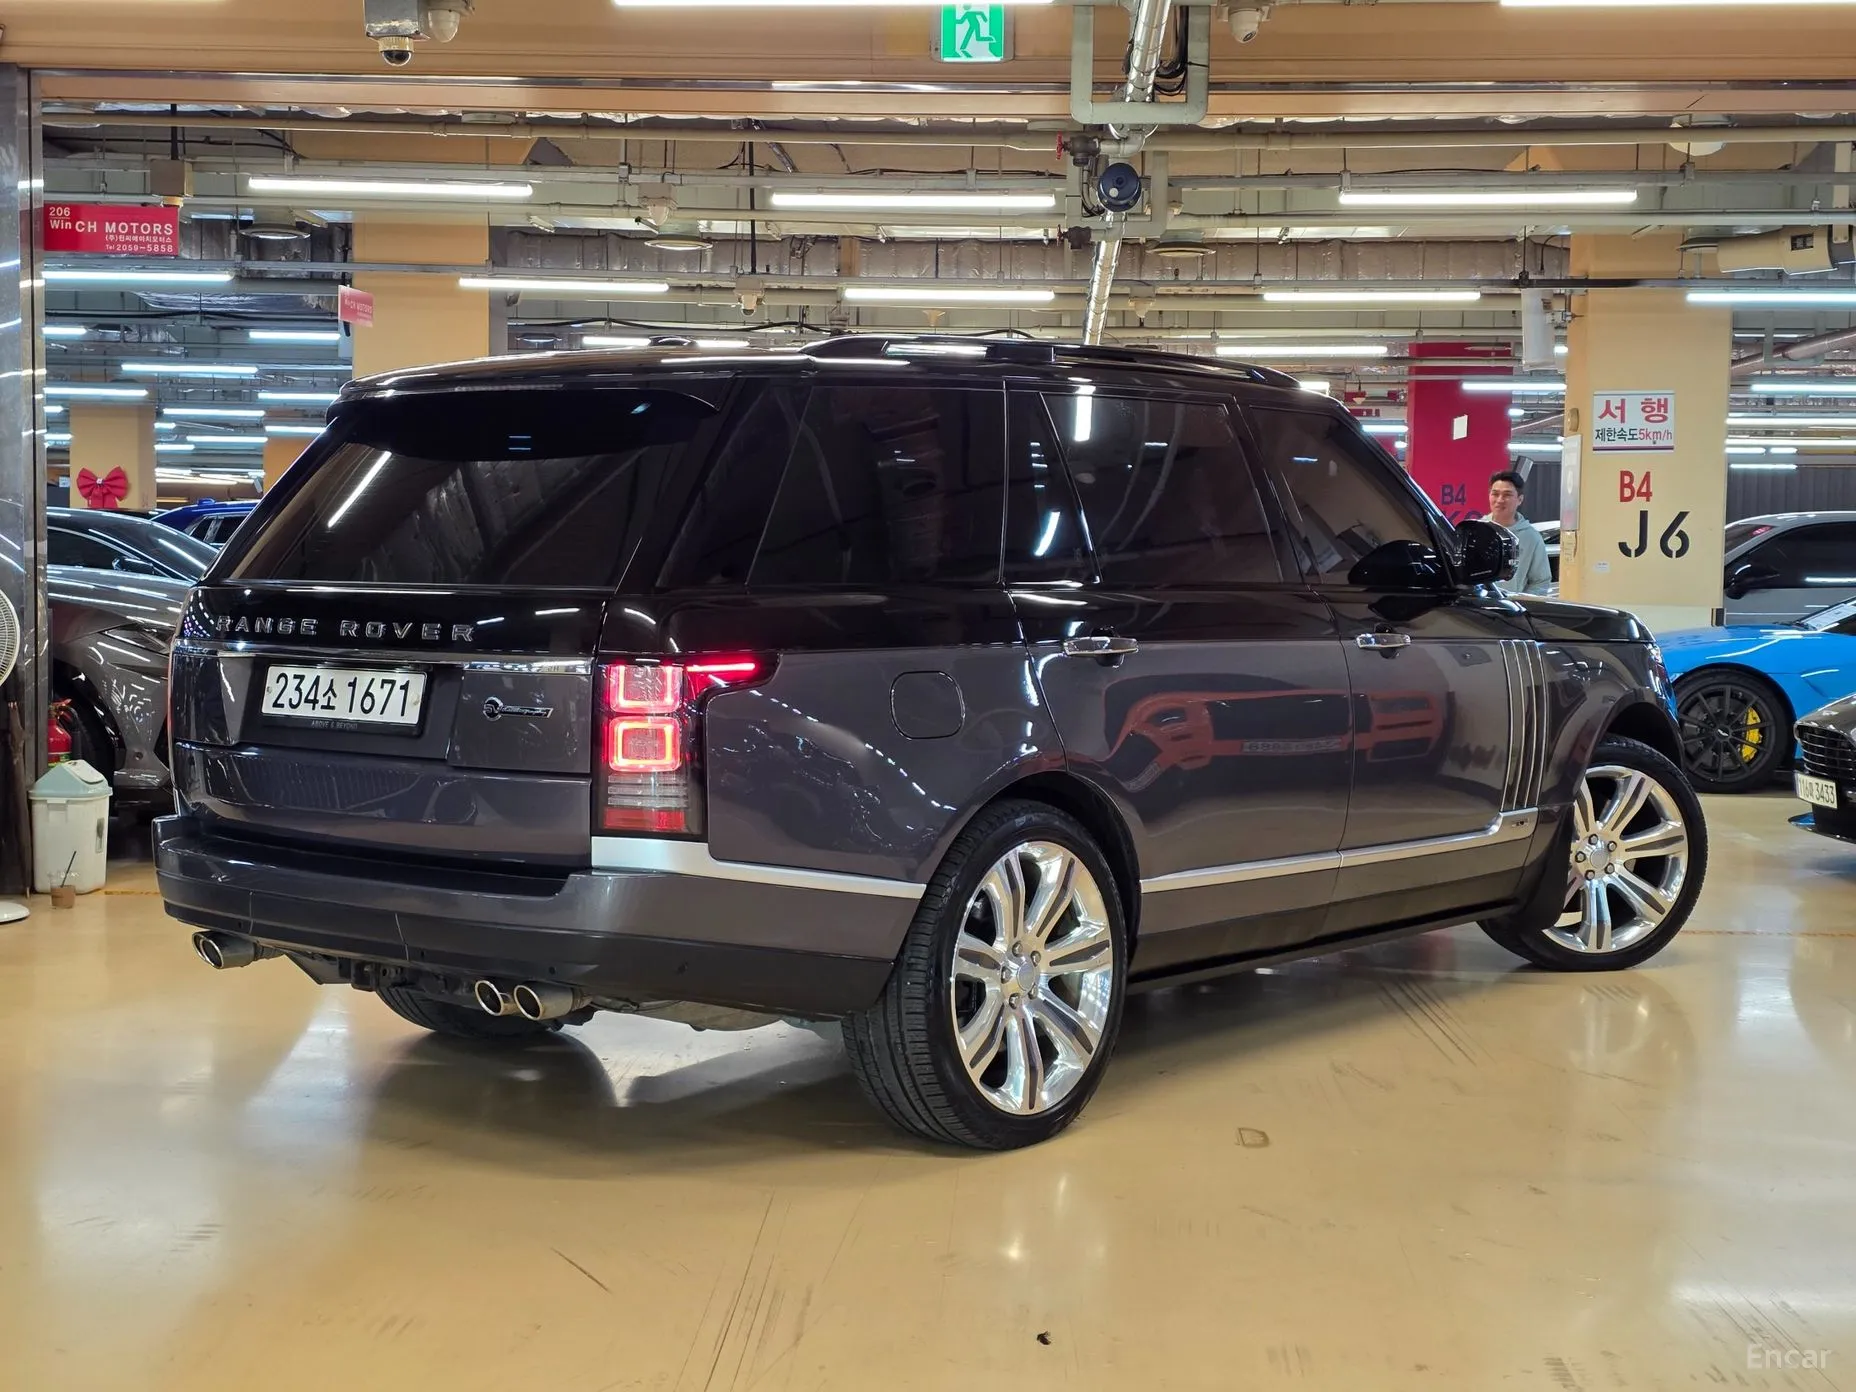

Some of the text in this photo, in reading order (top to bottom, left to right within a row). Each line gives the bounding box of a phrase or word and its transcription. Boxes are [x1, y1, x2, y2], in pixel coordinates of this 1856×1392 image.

[48, 206, 71, 217] 206
[49, 219, 173, 235] Win CH MOTORS
[1441, 483, 1466, 506] B4
[1620, 470, 1653, 502] B4
[1618, 509, 1690, 559] J6
[216, 615, 475, 642] RANGE ROVER
[272, 672, 410, 717] 234소 1671
[1815, 782, 1835, 804] 3433
